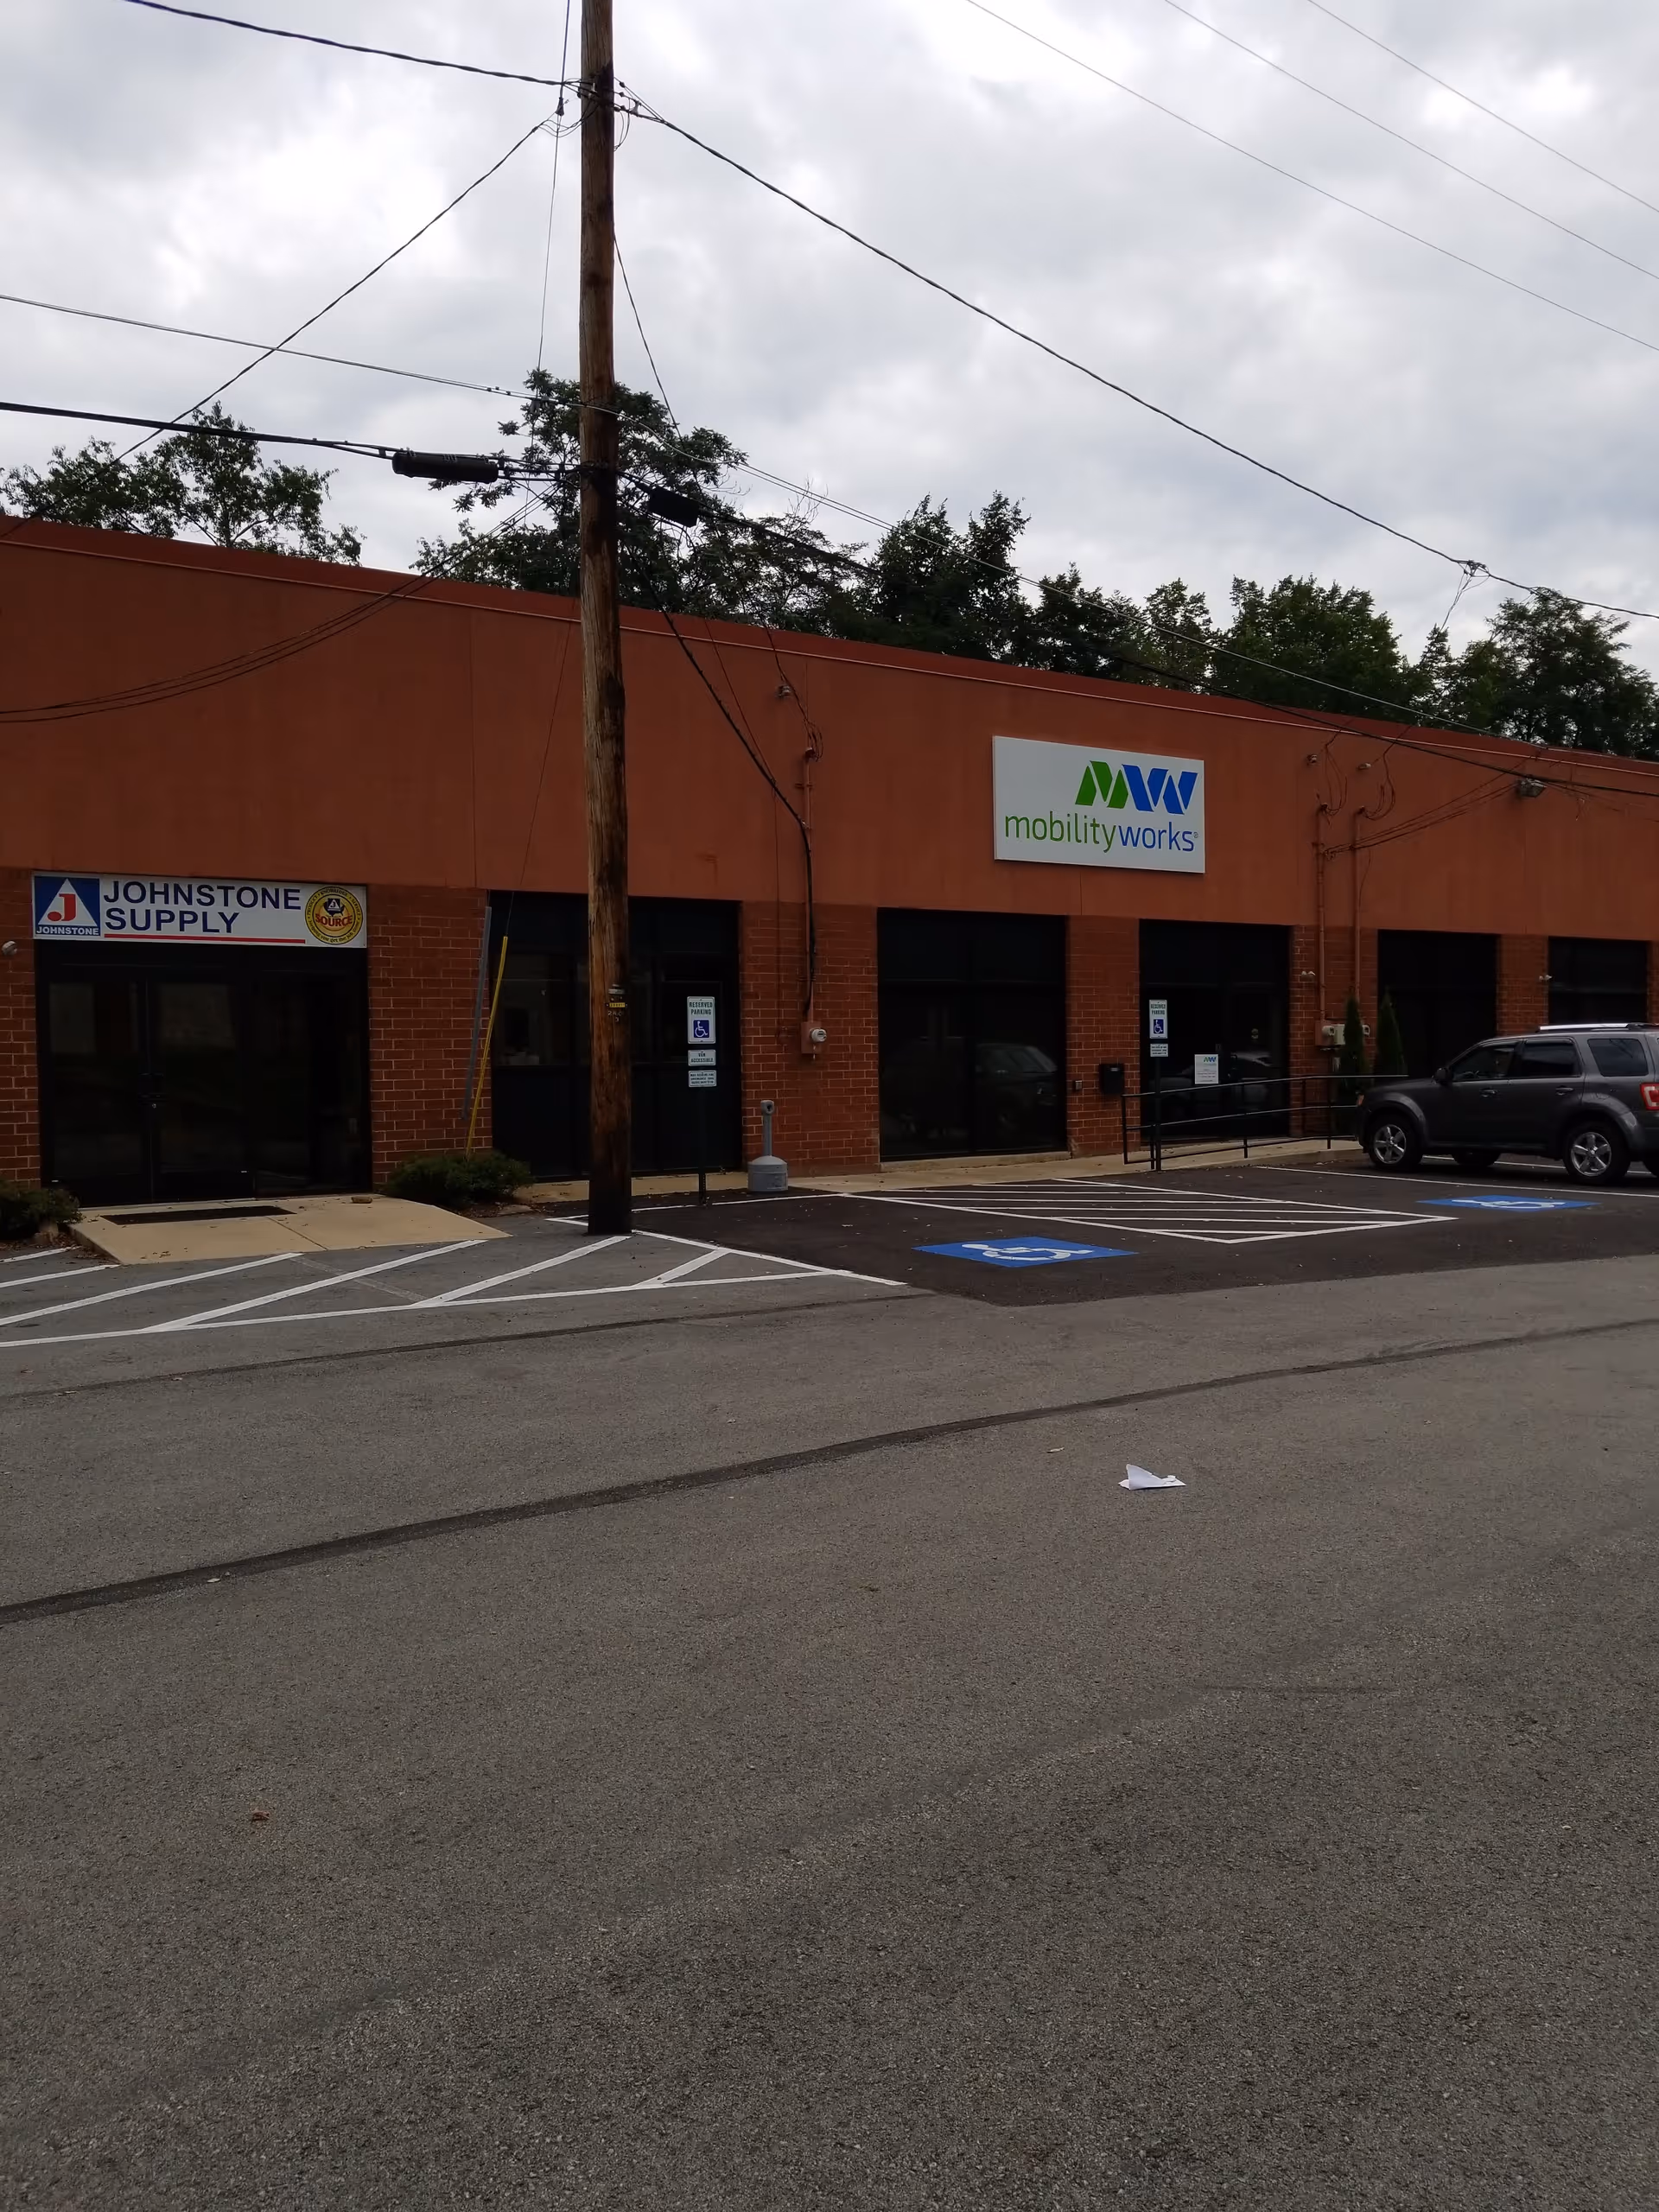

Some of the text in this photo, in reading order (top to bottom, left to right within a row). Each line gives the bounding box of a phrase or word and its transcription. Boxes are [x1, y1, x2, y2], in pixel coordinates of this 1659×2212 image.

[47, 893, 76, 922] J
[103, 880, 302, 910] JOHNSTONE
[36, 926, 99, 935] JOHNSTONE
[105, 907, 240, 934] SUPPLY
[315, 912, 353, 927] SOURCE
